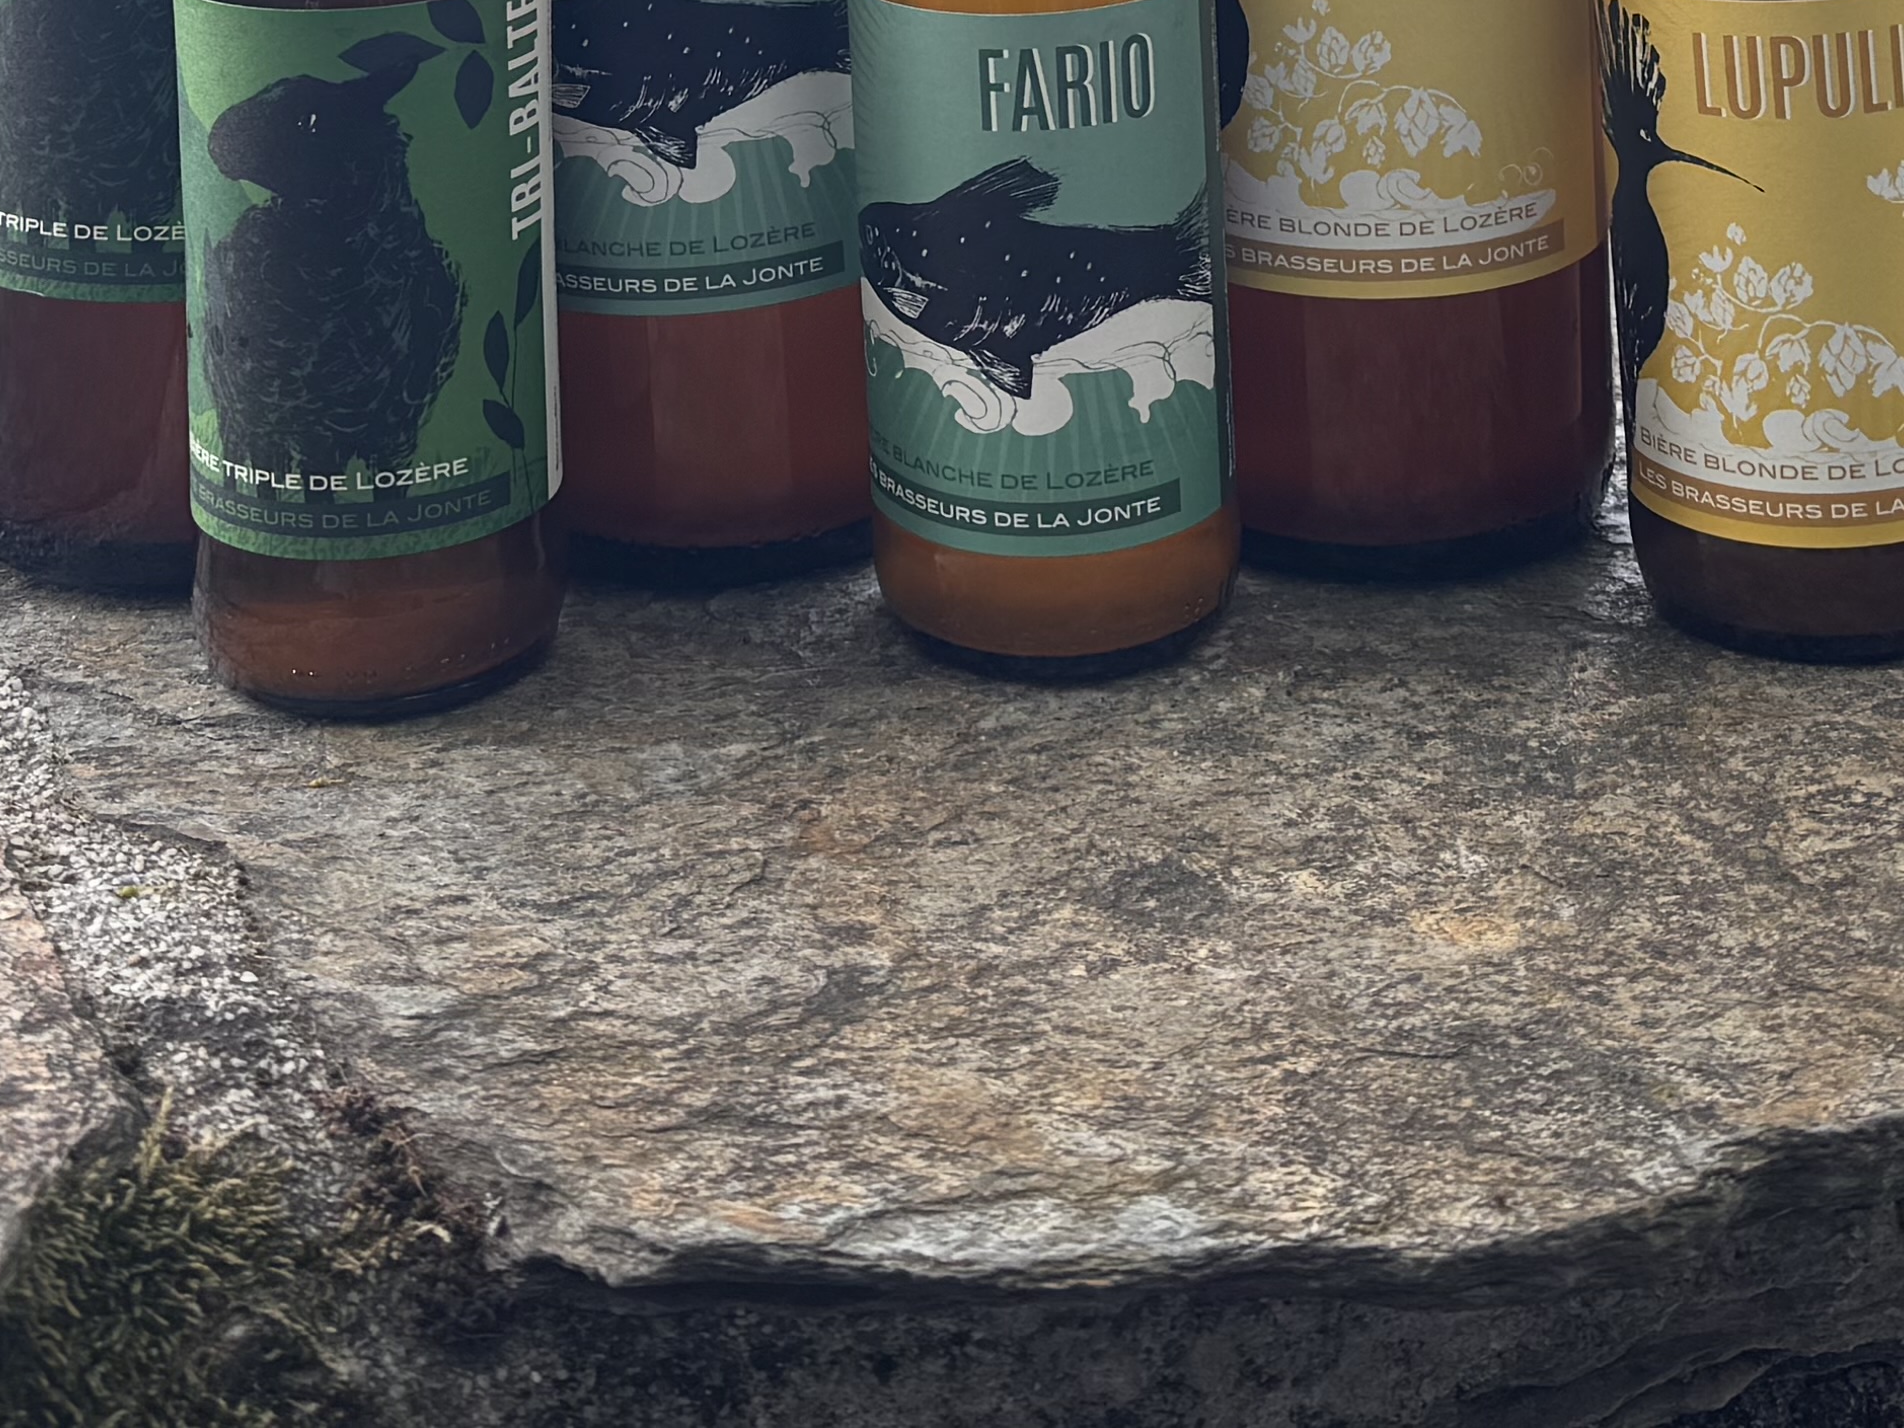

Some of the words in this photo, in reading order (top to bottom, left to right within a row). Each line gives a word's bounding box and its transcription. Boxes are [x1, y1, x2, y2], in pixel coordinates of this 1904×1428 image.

[978, 32, 1155, 132] FARIO
[74, 224, 109, 241] DE
[117, 220, 186, 242] LOZÈ
[563, 238, 662, 257] LANCHE
[669, 240, 706, 257] DE
[713, 222, 816, 253] LOZÈRE
[1226, 204, 1272, 230] ÈRE
[1279, 217, 1392, 238] BLONDE
[1399, 219, 1436, 237] DE
[1443, 201, 1538, 234] LOZÈRE
[84, 261, 118, 277] DE
[124, 263, 156, 277] LA
[556, 272, 658, 293] ASSEURS
[664, 277, 699, 293] DE
[705, 274, 737, 291] LA
[742, 257, 824, 287] JONTE
[1242, 247, 1394, 275] BRASSEURS
[1400, 257, 1436, 273] DE
[1442, 254, 1473, 271] LA
[1478, 234, 1550, 266] JONTE
[190, 431, 220, 472] ÈRE
[222, 459, 303, 490] TRIPLE
[309, 475, 348, 491] DE
[356, 458, 469, 490] LOZÈRE
[893, 445, 993, 489] BLANCHE
[1000, 474, 1038, 490] DE
[1046, 459, 1155, 490] LOZÈRE
[1640, 426, 1697, 466] BIÈRE
[1704, 449, 1820, 481] BLONDE
[1827, 463, 1867, 481] DE
[198, 483, 314, 529] BRASSEURS
[322, 514, 359, 529] DE
[367, 509, 399, 527] LA
[407, 489, 492, 522] JONTE
[878, 469, 987, 525] BRASSEURS
[994, 512, 1030, 528] DE
[1037, 511, 1071, 528] LA
[1077, 496, 1161, 527] JONTE
[1638, 461, 1668, 491] LES
[1671, 480, 1823, 520] BRASSEURS
[1831, 502, 1868, 518] DE
